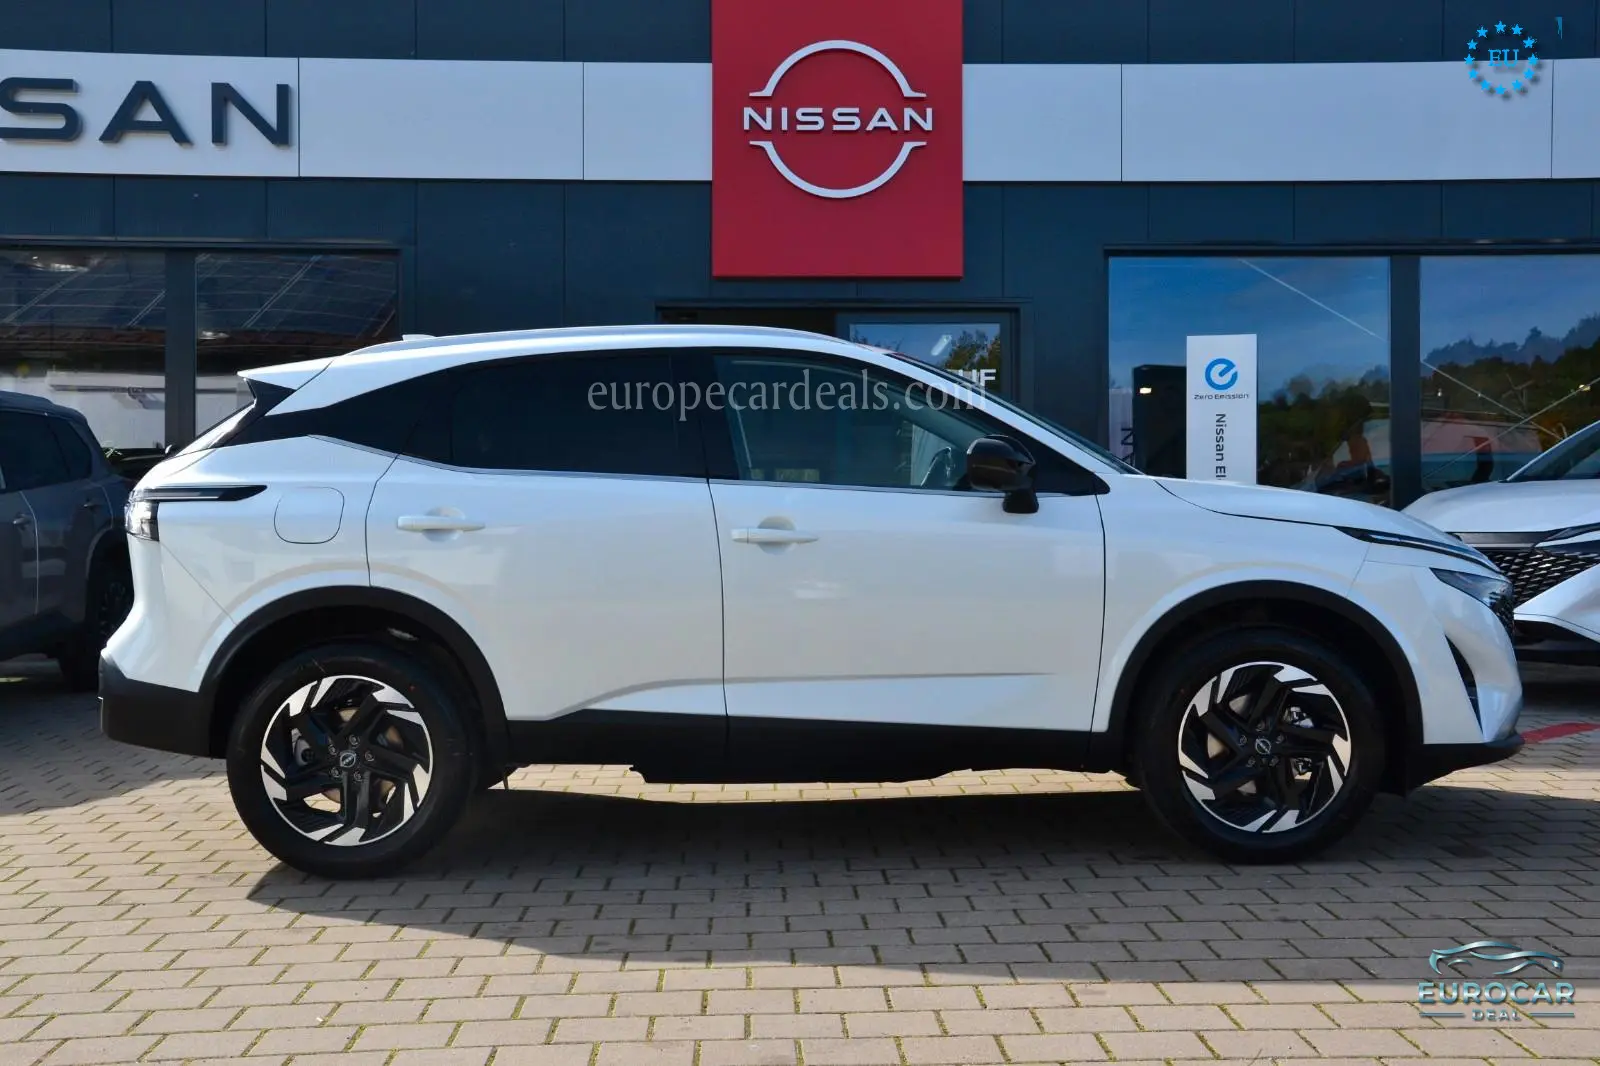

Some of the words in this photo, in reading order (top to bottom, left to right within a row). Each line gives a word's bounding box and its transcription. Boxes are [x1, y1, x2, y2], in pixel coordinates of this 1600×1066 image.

[0, 76, 292, 147] SAN
[743, 106, 933, 131] NISSAN
[1214, 392, 1249, 400] Emission
[1215, 413, 1227, 461] Nissan
[1215, 465, 1227, 480] El
